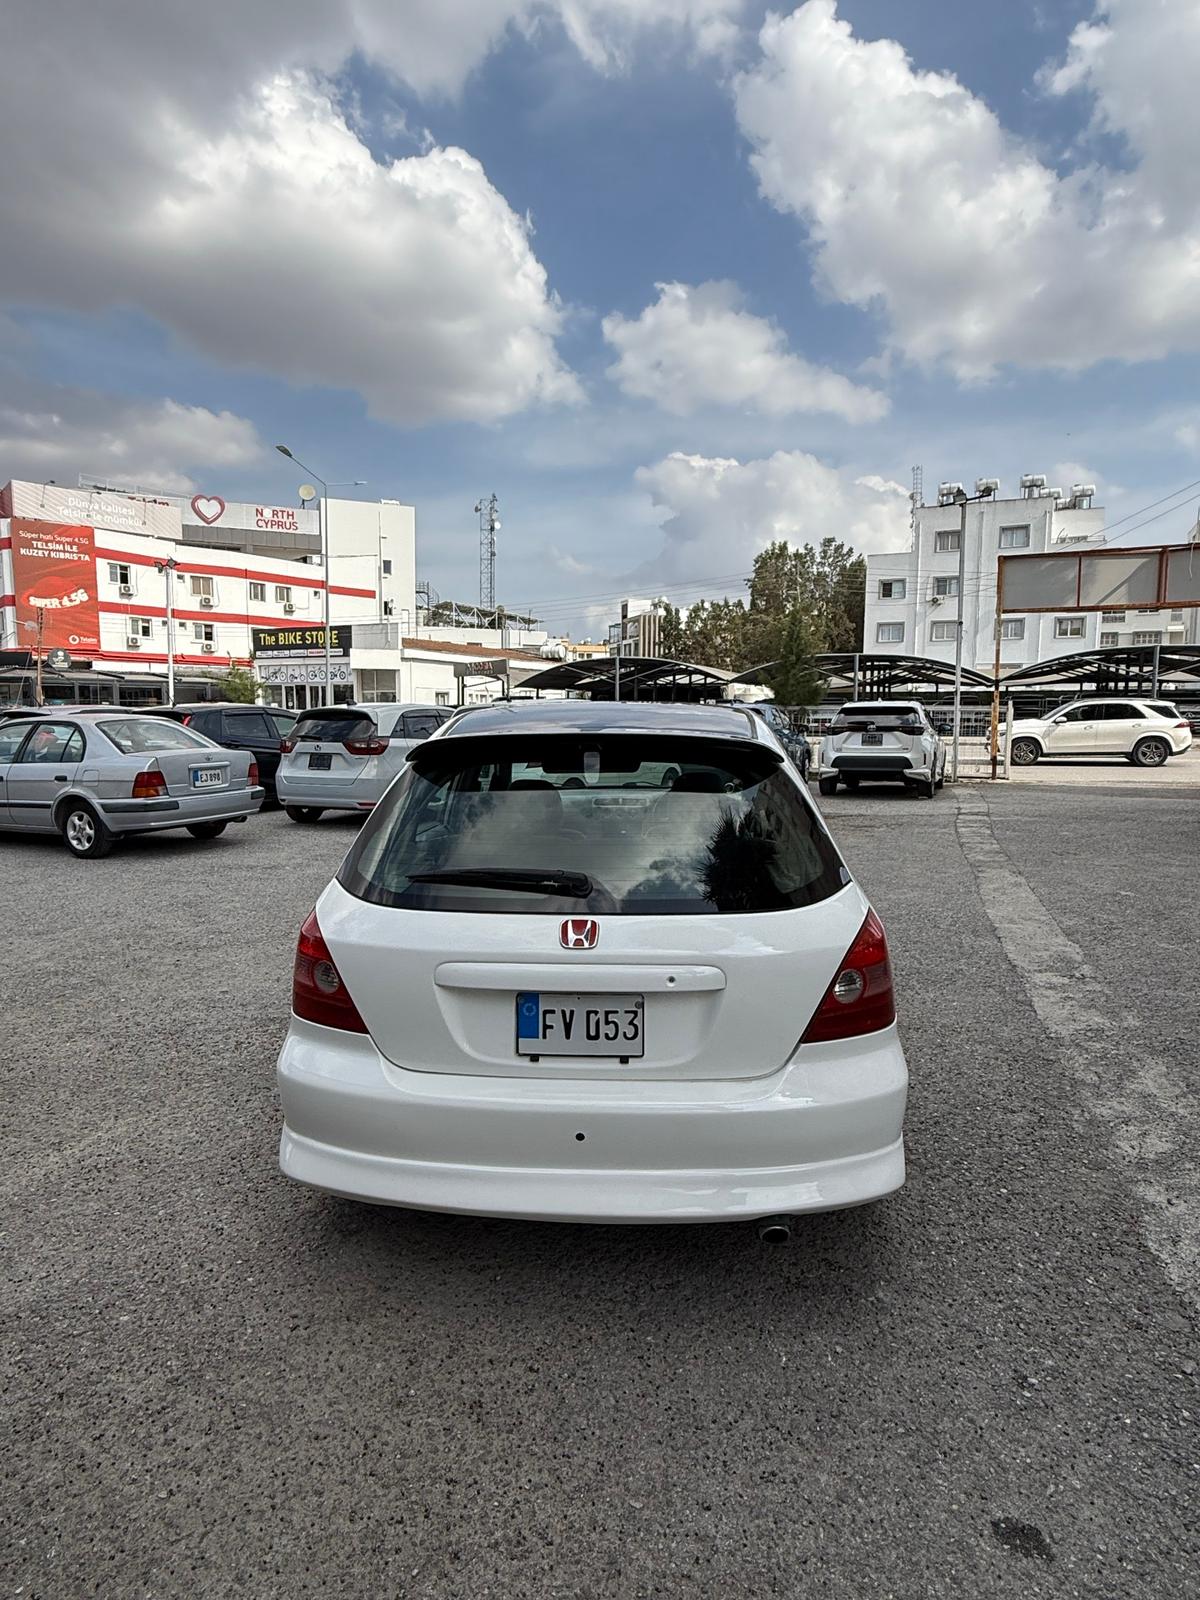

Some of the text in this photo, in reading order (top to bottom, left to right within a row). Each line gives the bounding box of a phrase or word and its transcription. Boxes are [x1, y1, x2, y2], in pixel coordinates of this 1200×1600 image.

[256, 519, 298, 531] CYPRUS
[32, 541, 63, 551] TELSİM
[20, 548, 49, 558] KUZEY
[259, 633, 276, 646] The
[278, 631, 303, 645] BIKE
[542, 1009, 639, 1041] FV 053
